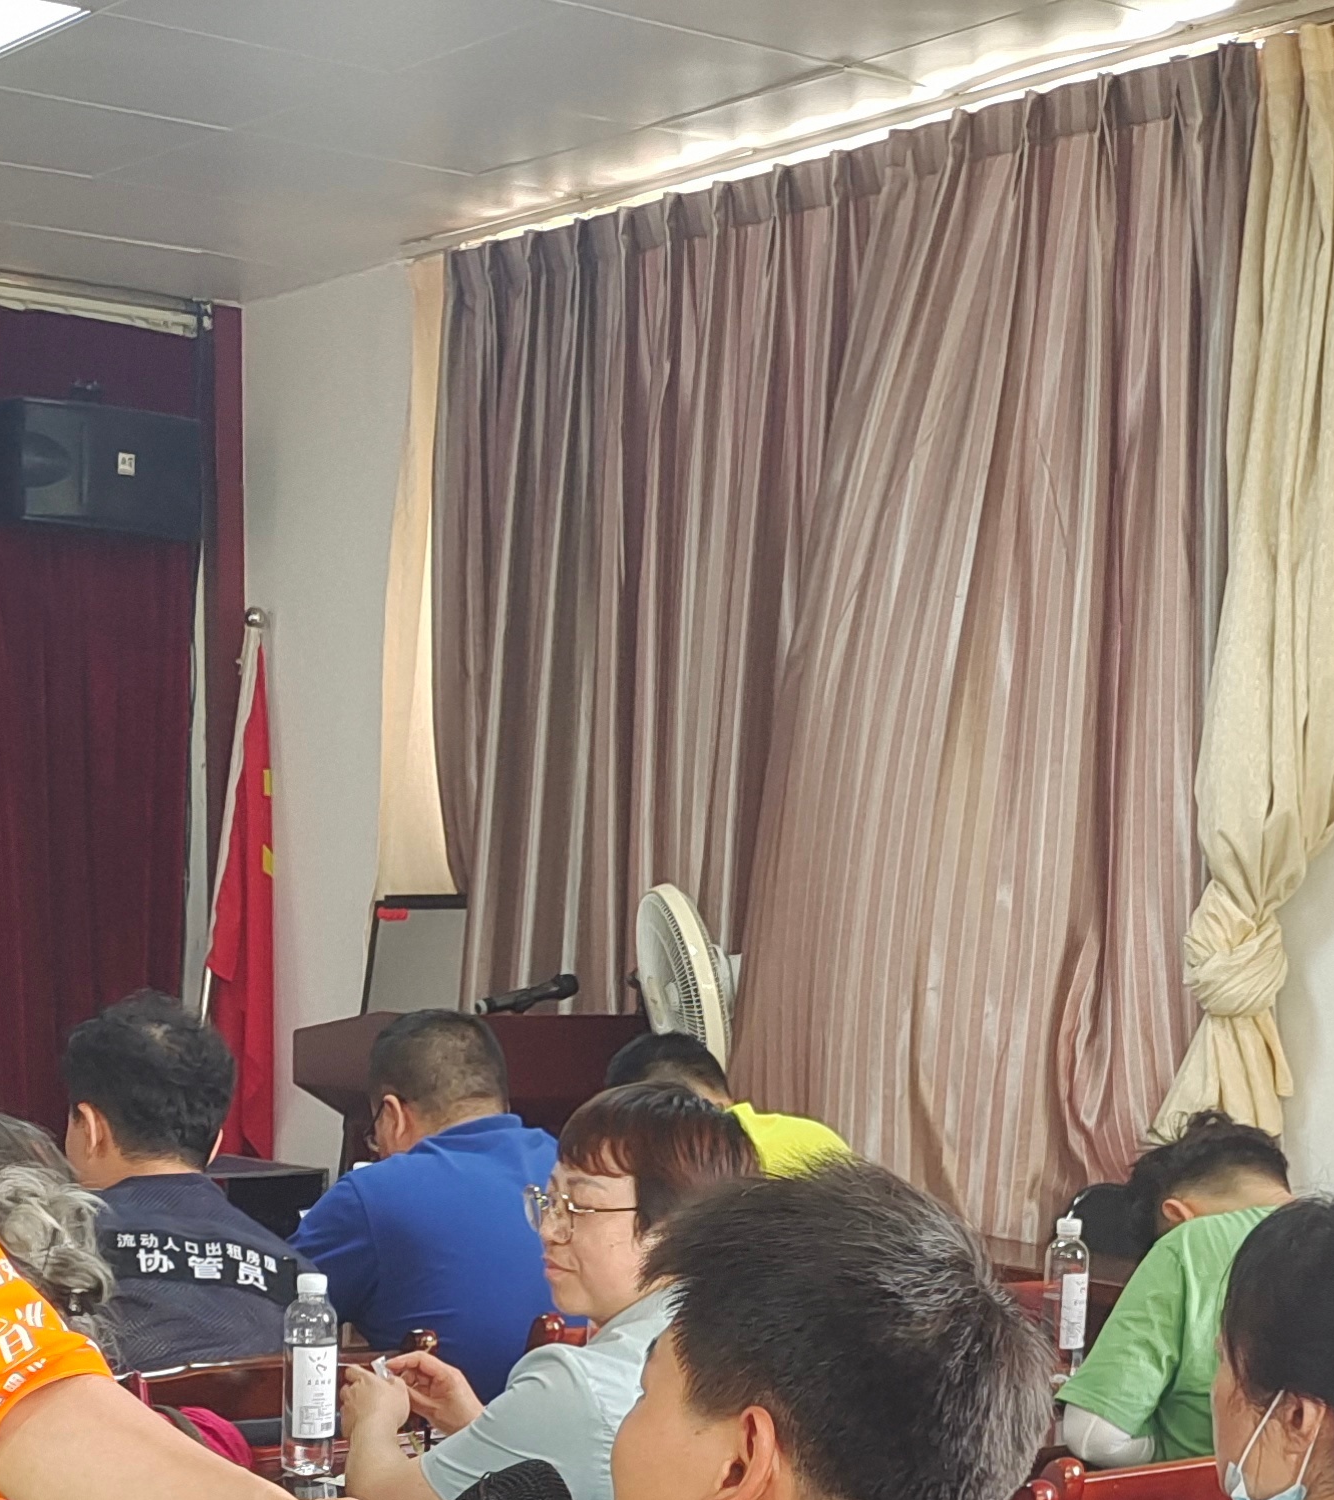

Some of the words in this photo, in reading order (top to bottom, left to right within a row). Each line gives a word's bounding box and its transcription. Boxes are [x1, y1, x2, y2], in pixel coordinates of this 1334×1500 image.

[117, 1232, 278, 1274] 流动人口出租房屋
[136, 1248, 268, 1291] 协管员
